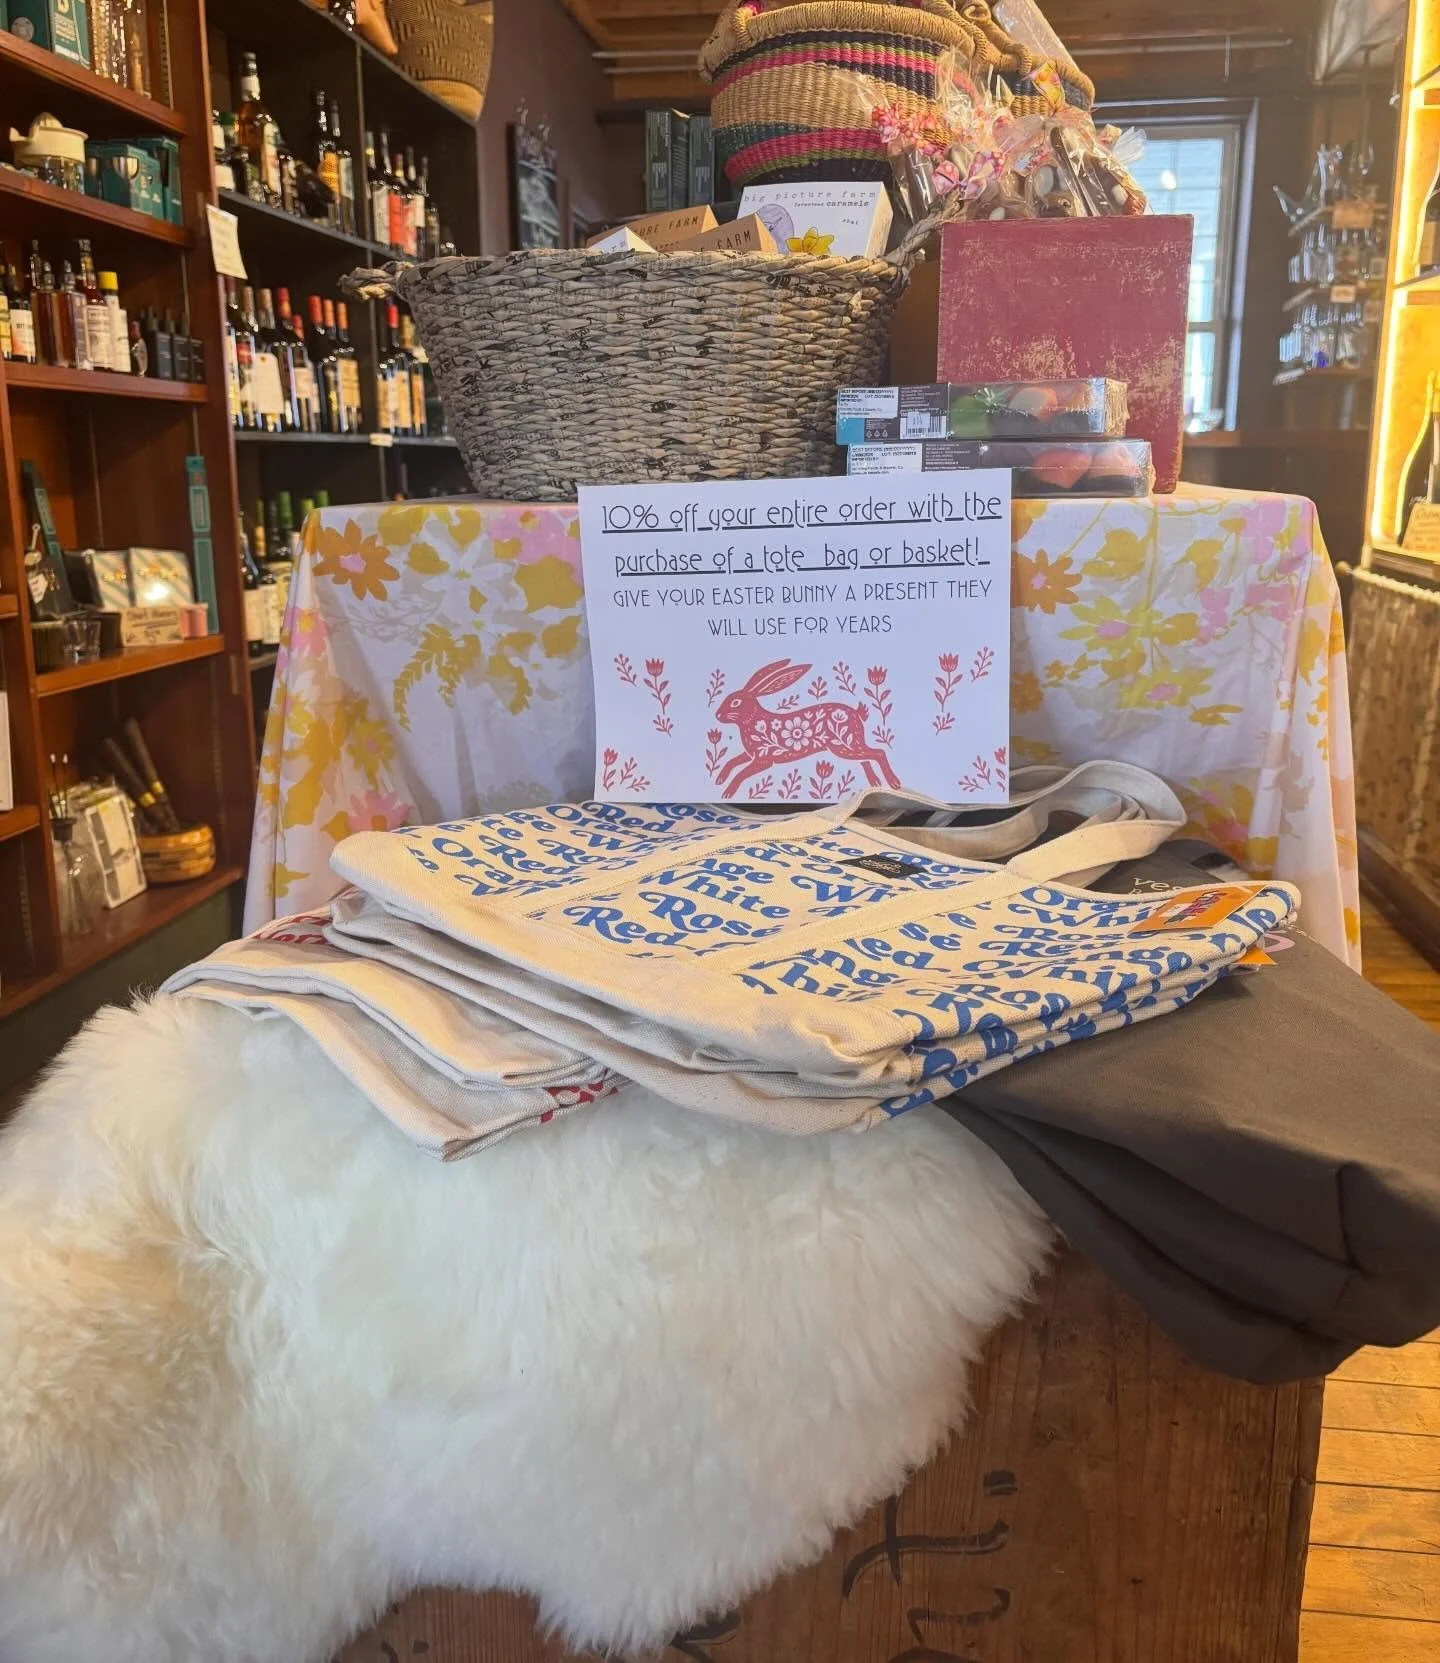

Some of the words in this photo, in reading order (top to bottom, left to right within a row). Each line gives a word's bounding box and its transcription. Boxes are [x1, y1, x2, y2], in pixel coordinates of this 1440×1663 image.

[744, 194, 766, 203] big
[776, 191, 832, 201] picture
[841, 190, 877, 199] farm
[668, 215, 699, 231] FARM
[603, 504, 659, 529] 10%
[670, 503, 698, 533] off
[709, 507, 757, 532] your
[767, 499, 828, 529] entire
[839, 496, 897, 522] order
[908, 493, 953, 523] with
[965, 491, 1001, 521] the
[615, 548, 702, 578] purchase
[713, 546, 734, 575] of
[745, 552, 753, 569] a
[764, 545, 805, 574] tote
[825, 543, 858, 570] bag
[869, 547, 892, 565] or
[904, 537, 979, 567] basket!
[613, 589, 650, 608] GIVE
[657, 589, 705, 607] YOUR
[712, 586, 774, 605] EASTER
[782, 584, 837, 604] BUNNY
[845, 584, 857, 602] A
[864, 581, 939, 600] PRESENT
[947, 579, 992, 599] THEY
[707, 618, 748, 636] WILL
[755, 617, 788, 635] USE
[795, 616, 828, 634] FOR
[836, 615, 892, 634] YEARS
[580, 801, 681, 835] Red
[562, 905, 698, 951] Red
